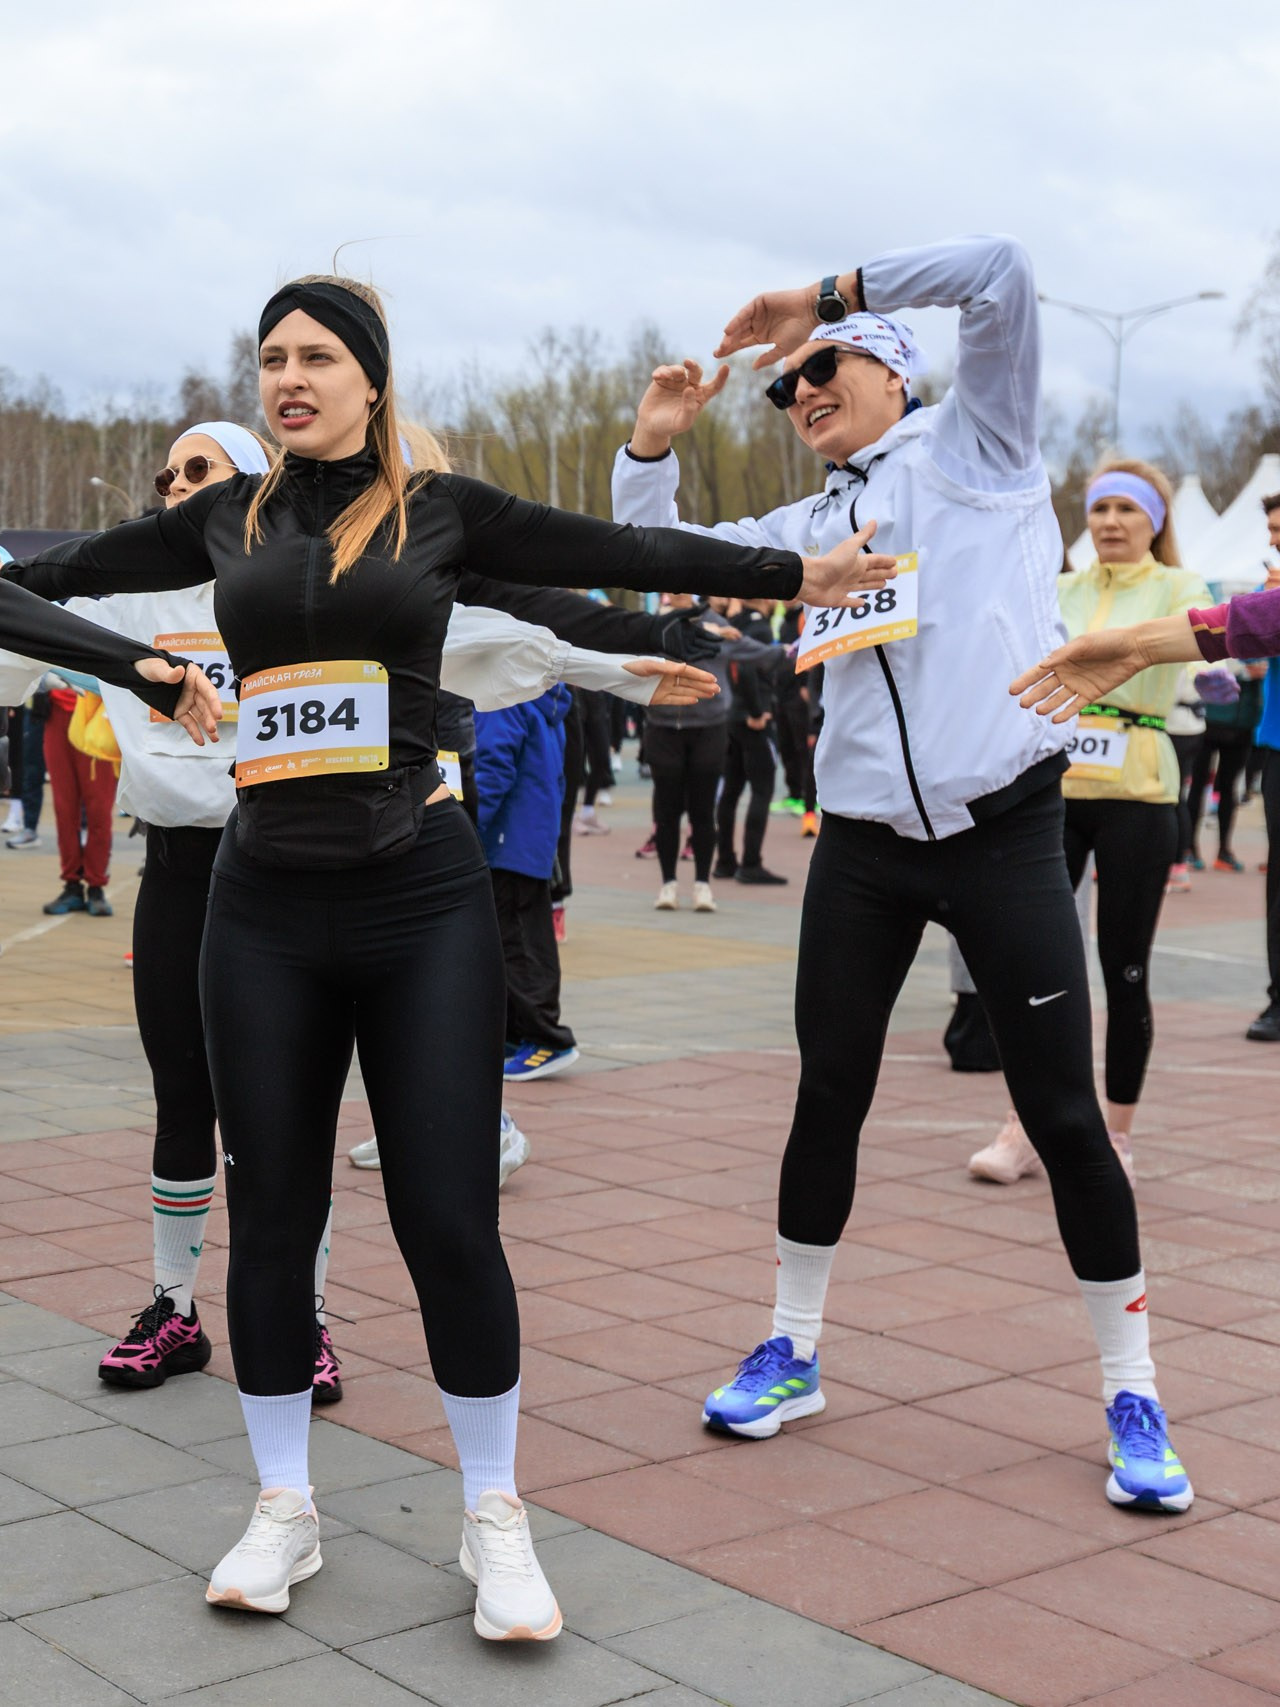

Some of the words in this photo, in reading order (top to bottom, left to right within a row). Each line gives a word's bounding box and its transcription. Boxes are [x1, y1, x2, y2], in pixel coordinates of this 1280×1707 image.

[816, 323, 858, 340] ORERO
[812, 587, 897, 637] 3768
[245, 672, 291, 692] МАЙСКАЯ
[293, 669, 323, 680] ГРОЗА
[255, 697, 360, 742] 3184
